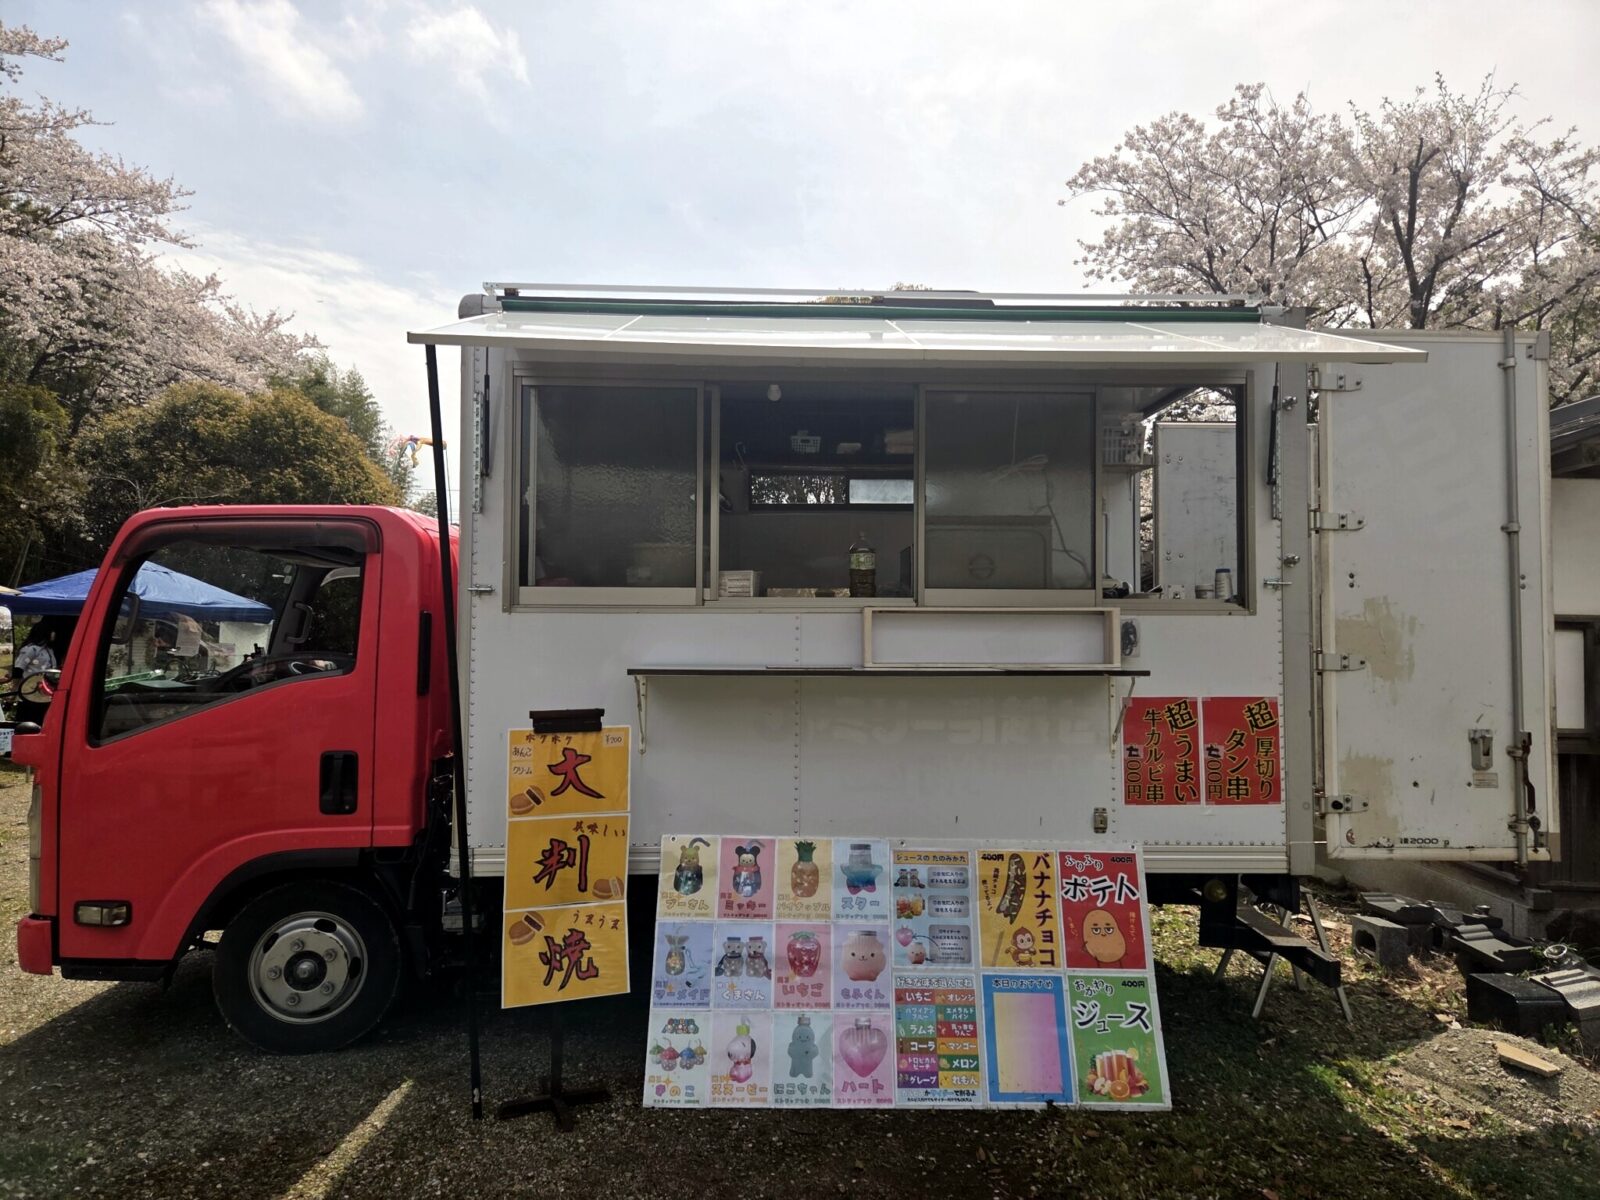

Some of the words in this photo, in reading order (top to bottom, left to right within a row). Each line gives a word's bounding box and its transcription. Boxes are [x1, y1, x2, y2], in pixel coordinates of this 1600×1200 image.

[511, 747, 533, 758] あんこ
[1144, 708, 1166, 804] 牛カルビ串
[1164, 699, 1198, 802] 超うまい
[1243, 699, 1278, 800] 超厚切り
[1225, 728, 1250, 801] タン串
[1061, 872, 1140, 907] ポテト
[841, 896, 880, 910] スター
[1032, 852, 1056, 967] バナナチョコ
[722, 989, 765, 1001] くまさん
[1075, 979, 1115, 997] おかわり
[905, 991, 933, 1002] いちご
[1073, 1000, 1152, 1034] ジュース
[910, 1024, 935, 1035] ラムネ
[910, 1041, 936, 1051] コーラ
[948, 1042, 977, 1050] マンゴー
[952, 1059, 977, 1069] メロン
[773, 1082, 832, 1095] にこちゃん
[841, 1079, 885, 1095] ハート
